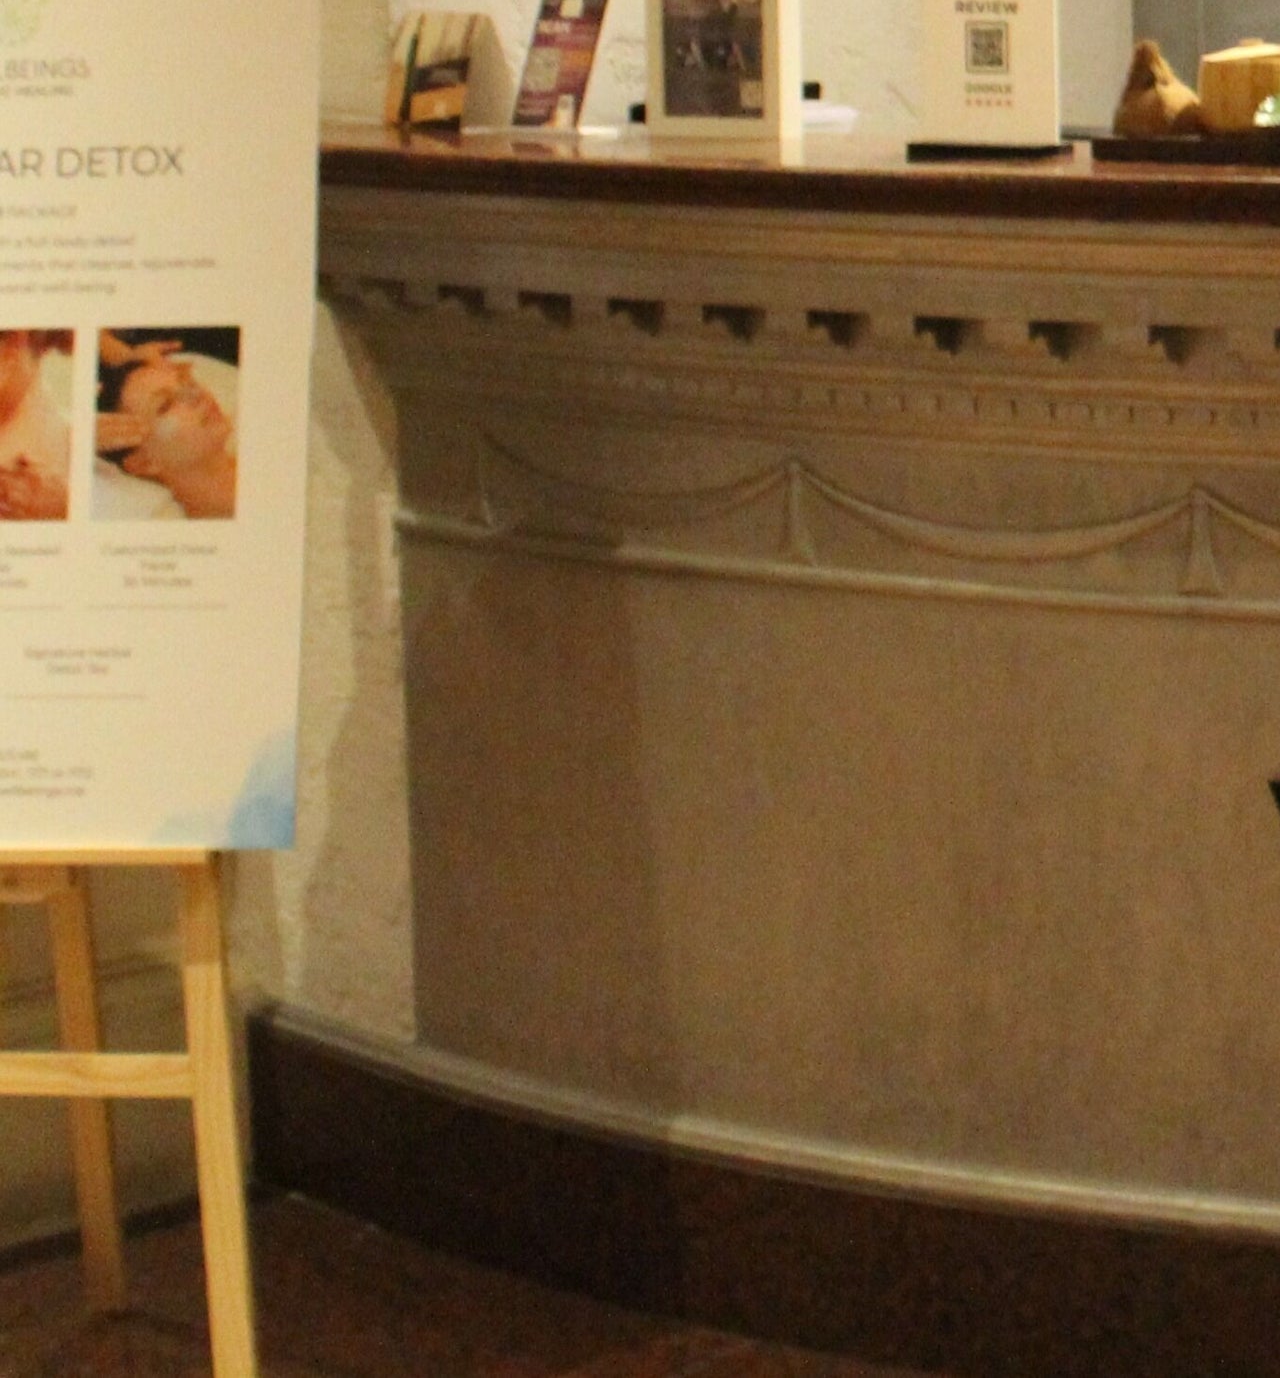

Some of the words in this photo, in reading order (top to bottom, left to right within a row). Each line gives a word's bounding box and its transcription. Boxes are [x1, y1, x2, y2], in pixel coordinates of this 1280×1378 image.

[954, 0, 1019, 14] REVIEW
[0, 58, 91, 80] BEINGS
[56, 145, 185, 179] DETOX
